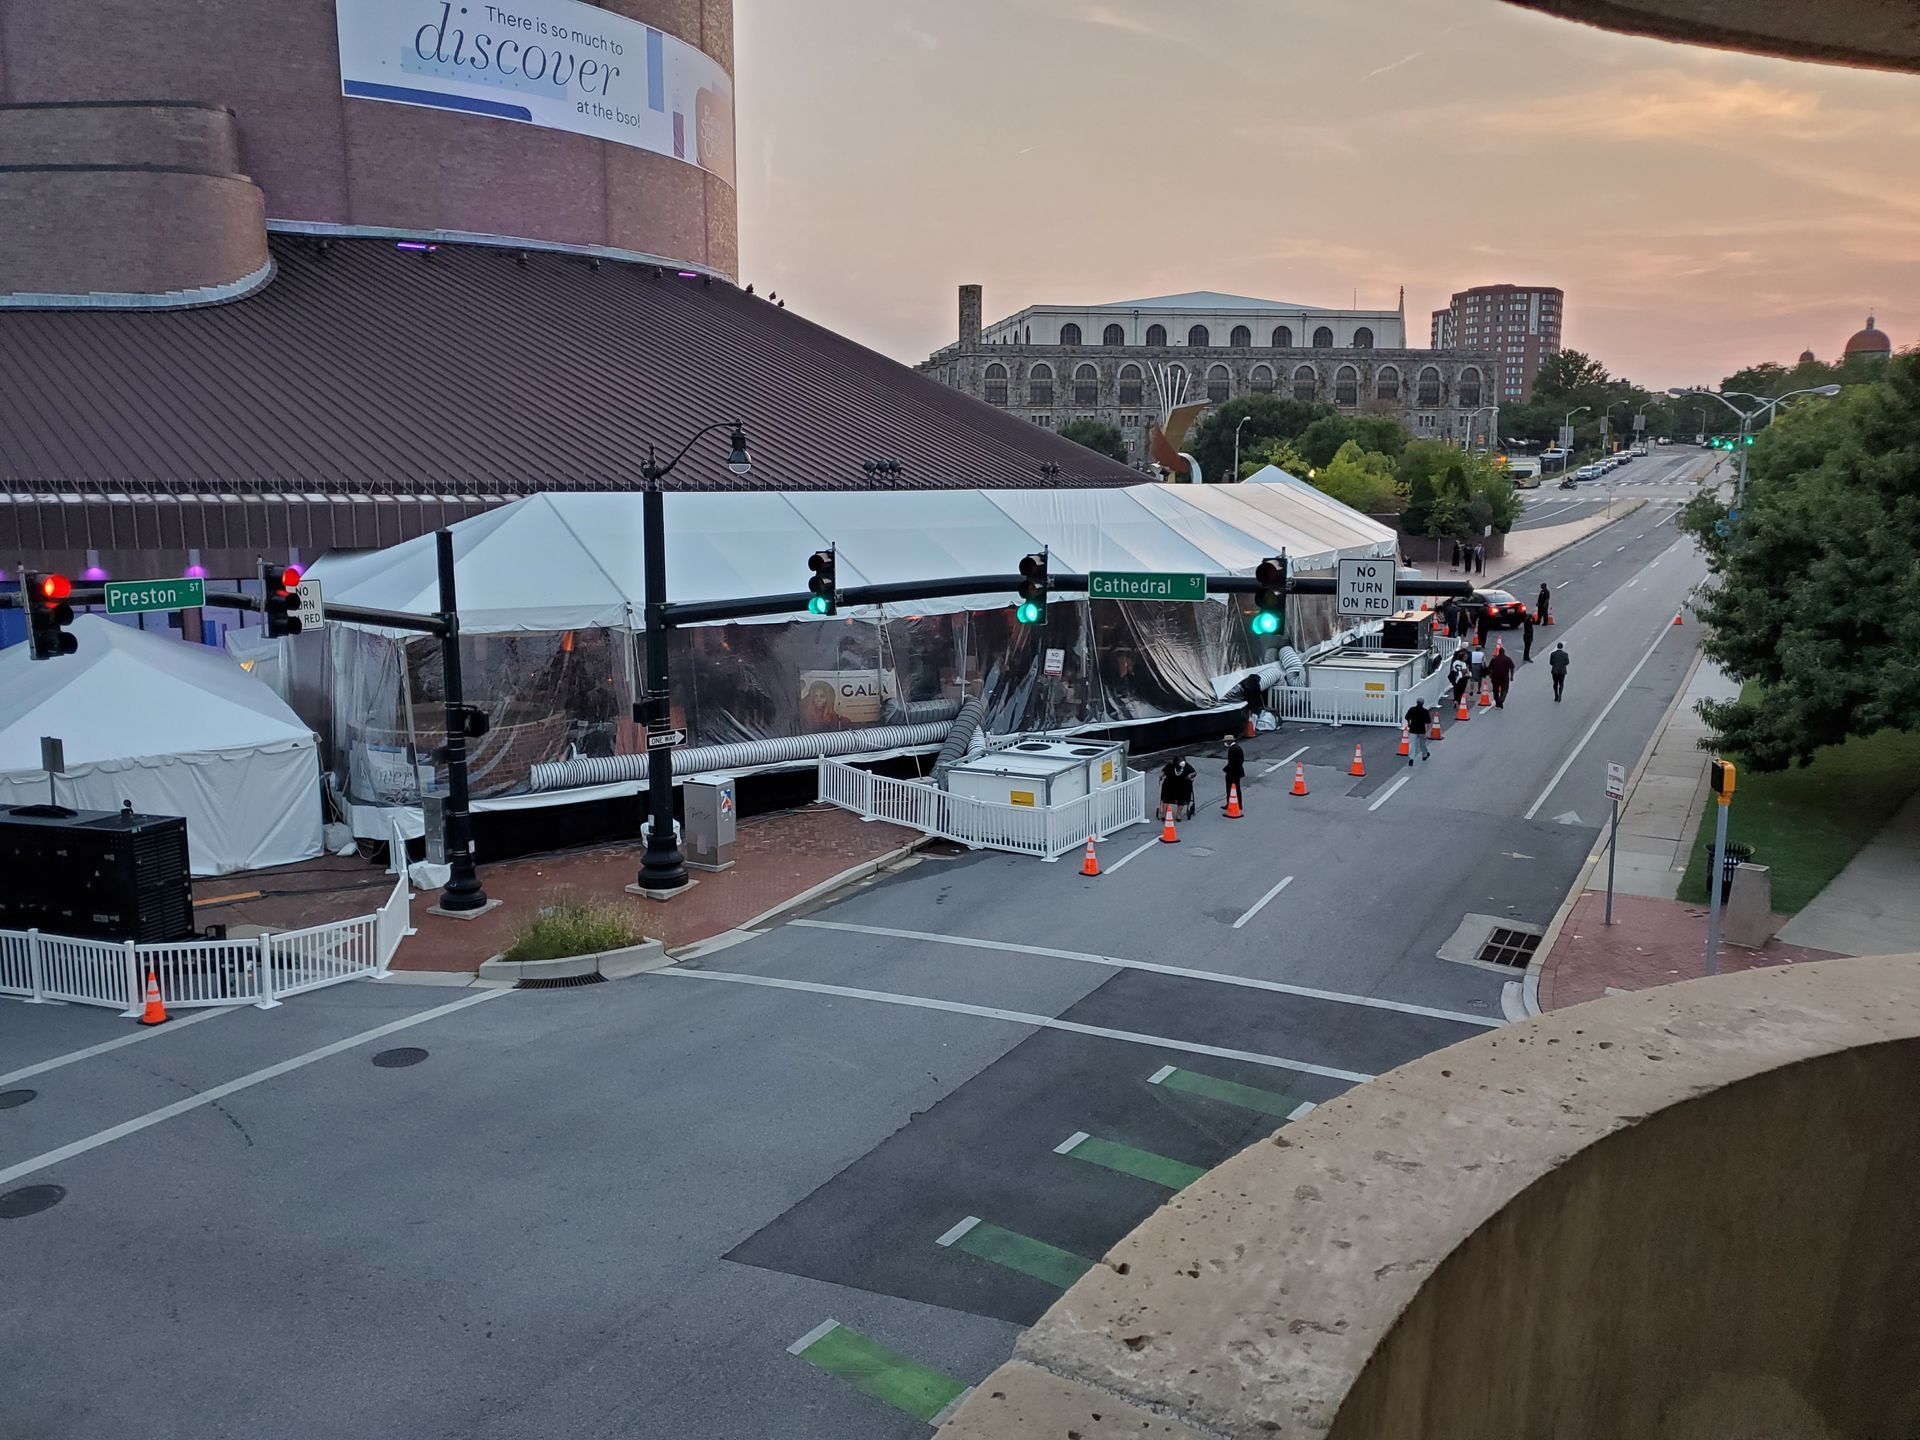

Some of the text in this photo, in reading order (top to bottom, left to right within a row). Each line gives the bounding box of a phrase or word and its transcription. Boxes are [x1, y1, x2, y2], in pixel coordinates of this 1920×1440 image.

[485, 5, 623, 55] There is so much to
[415, 1, 620, 96] discover
[577, 101, 640, 128] at the bso!
[1357, 566, 1376, 577] NO
[1093, 577, 1201, 594] Cathedral ST
[1350, 582, 1382, 593] TURN
[110, 583, 199, 607] Preston ST
[1343, 597, 1389, 609] ON RED
[304, 613, 320, 623] RED
[841, 683, 888, 697] GALA
